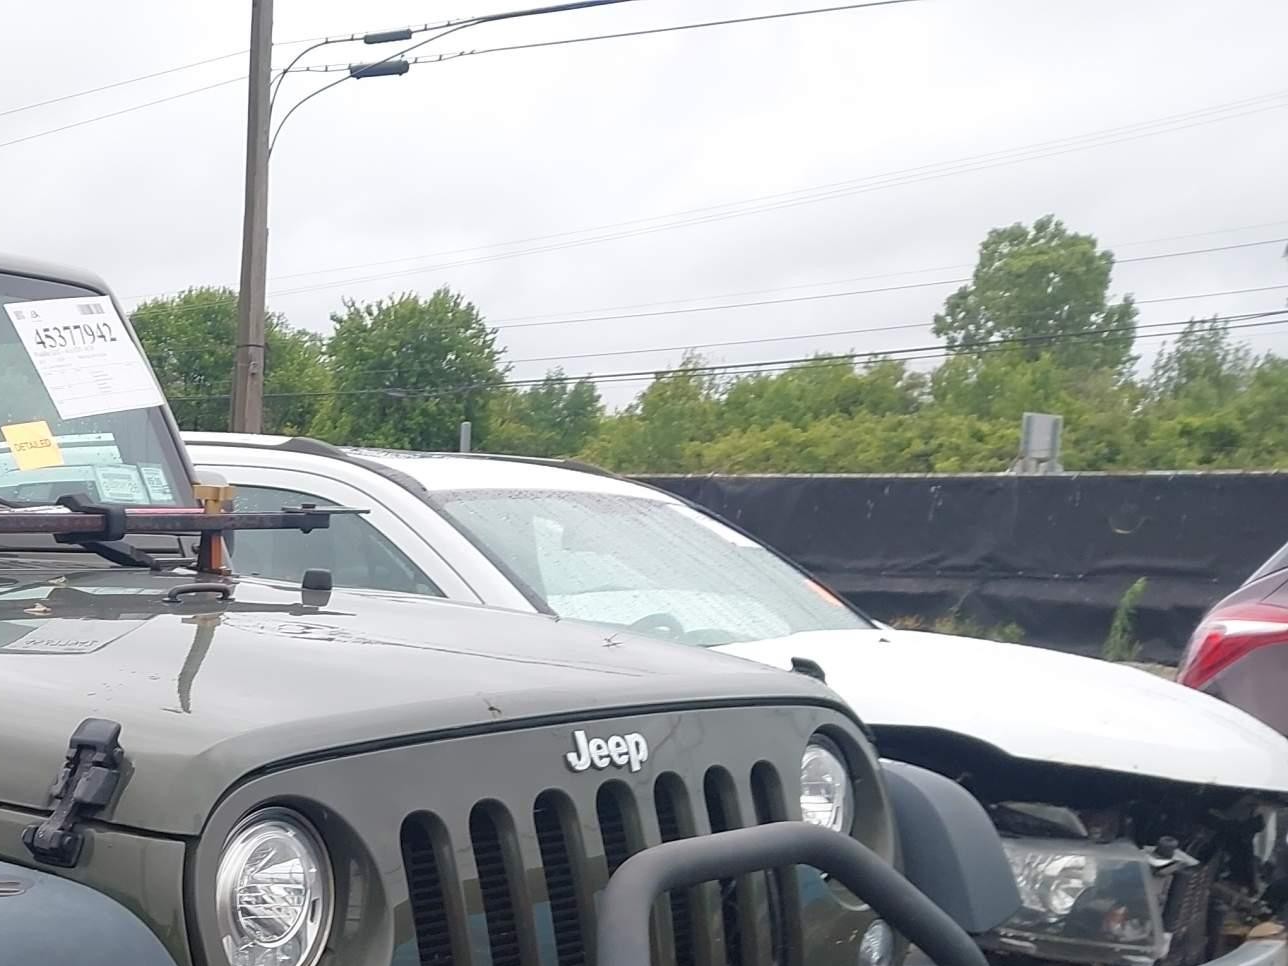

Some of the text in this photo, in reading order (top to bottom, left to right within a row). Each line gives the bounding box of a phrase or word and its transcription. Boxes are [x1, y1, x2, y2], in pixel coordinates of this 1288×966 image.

[34, 321, 117, 349] 45377942
[13, 438, 52, 452] DETAILED
[567, 730, 649, 772] Jeep
